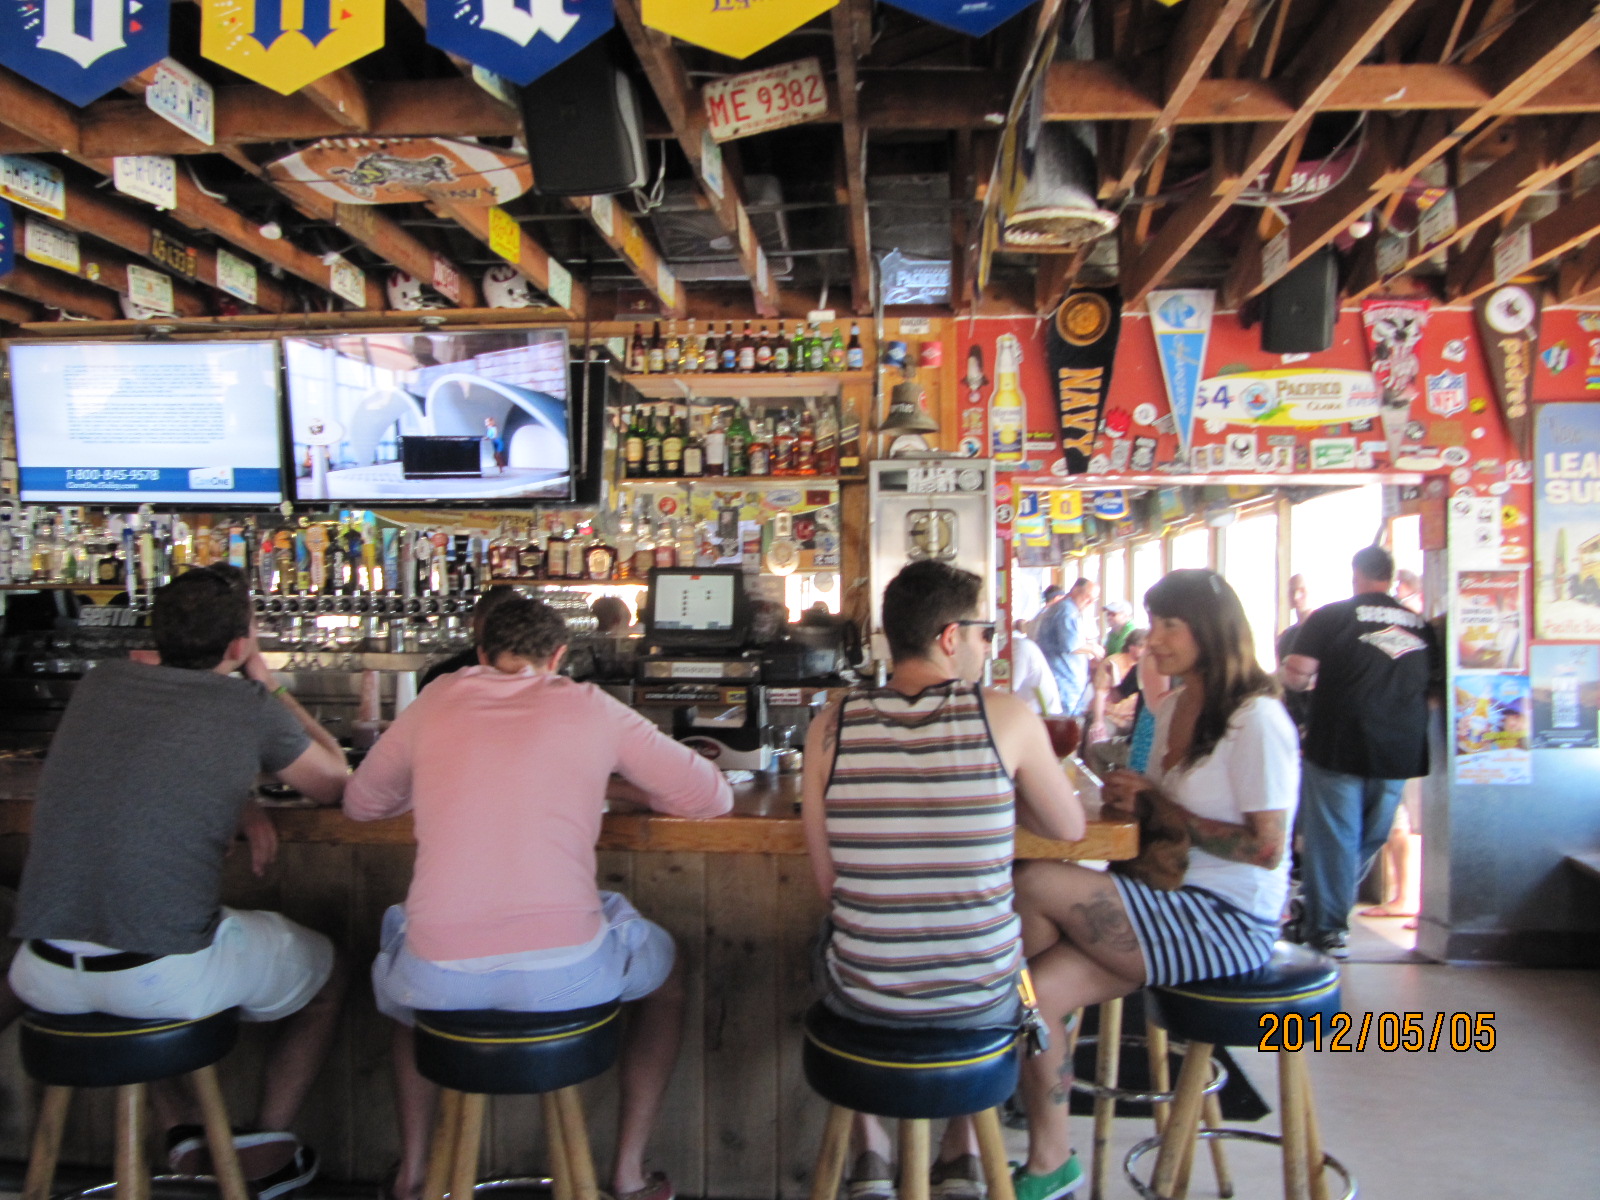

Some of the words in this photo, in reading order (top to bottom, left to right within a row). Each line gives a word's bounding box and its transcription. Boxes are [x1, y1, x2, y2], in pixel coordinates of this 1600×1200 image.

[707, 88, 752, 127] ME
[756, 74, 823, 114] 9382
[1058, 366, 1105, 457] NAVY
[1543, 451, 1600, 479] LEA
